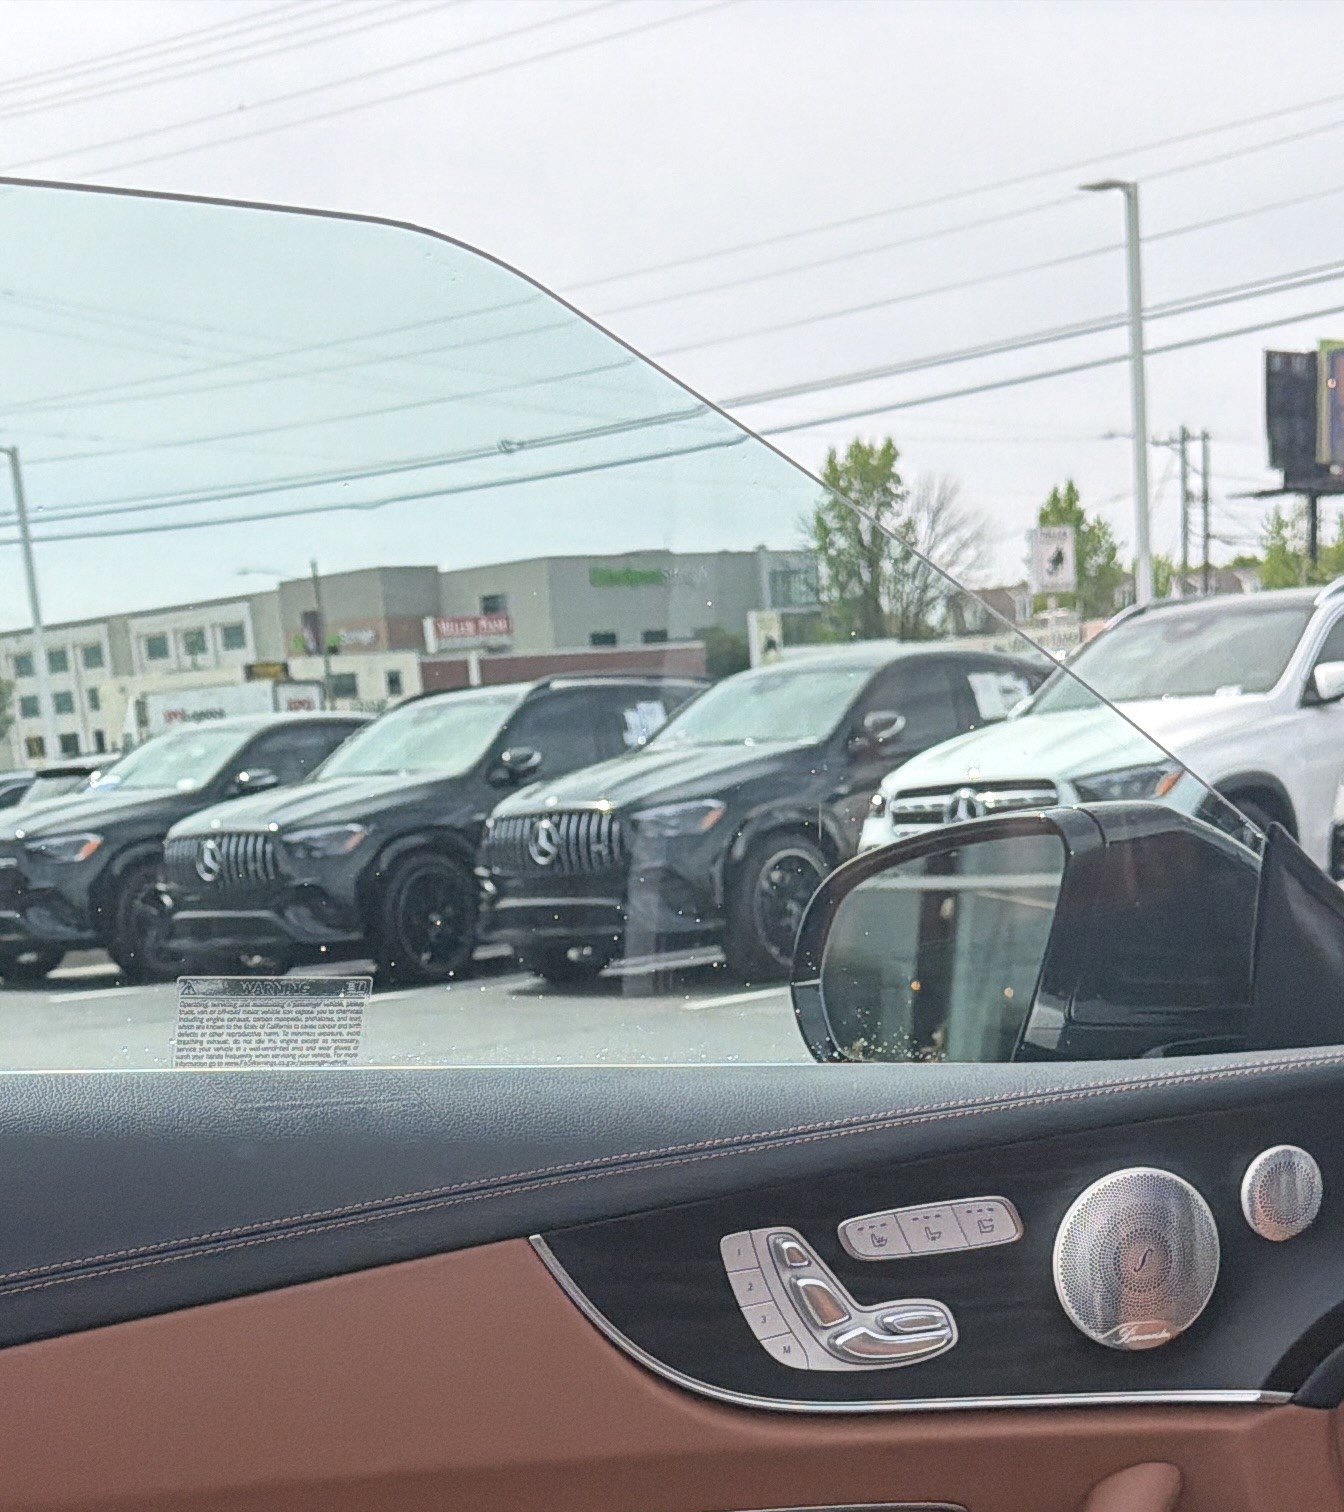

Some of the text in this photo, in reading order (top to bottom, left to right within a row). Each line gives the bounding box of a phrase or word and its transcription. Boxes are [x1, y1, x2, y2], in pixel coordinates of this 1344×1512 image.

[747, 1283, 753, 1291] 2
[760, 1315, 767, 1324] 3
[783, 1345, 791, 1354] M
